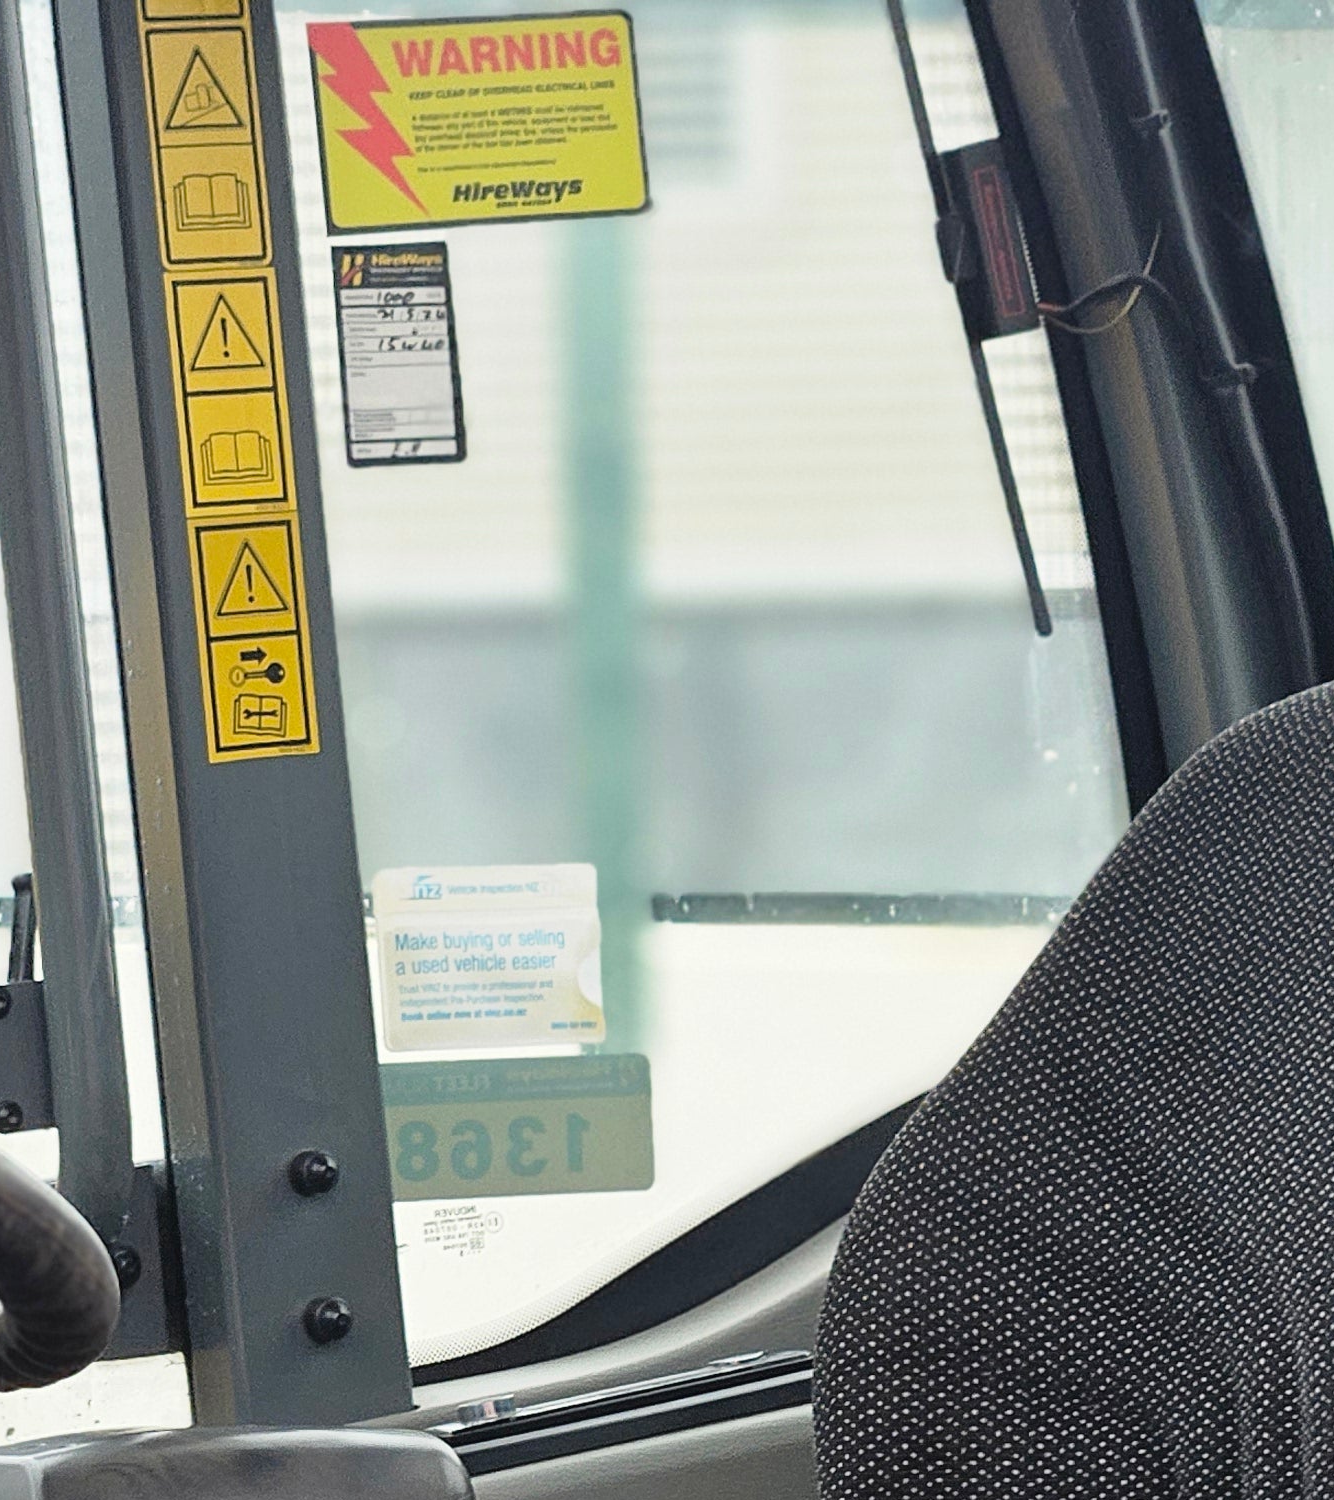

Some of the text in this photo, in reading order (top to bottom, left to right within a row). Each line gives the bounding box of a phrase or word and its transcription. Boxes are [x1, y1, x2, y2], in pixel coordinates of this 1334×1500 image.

[391, 28, 622, 78] WARNING
[408, 88, 434, 100] KEEP
[436, 87, 466, 99] CLEAR
[535, 81, 588, 94] ELECTRICAL
[453, 179, 584, 204] HireWays
[394, 928, 566, 952] Make buying or selling
[395, 953, 556, 976] a used vehicle easier
